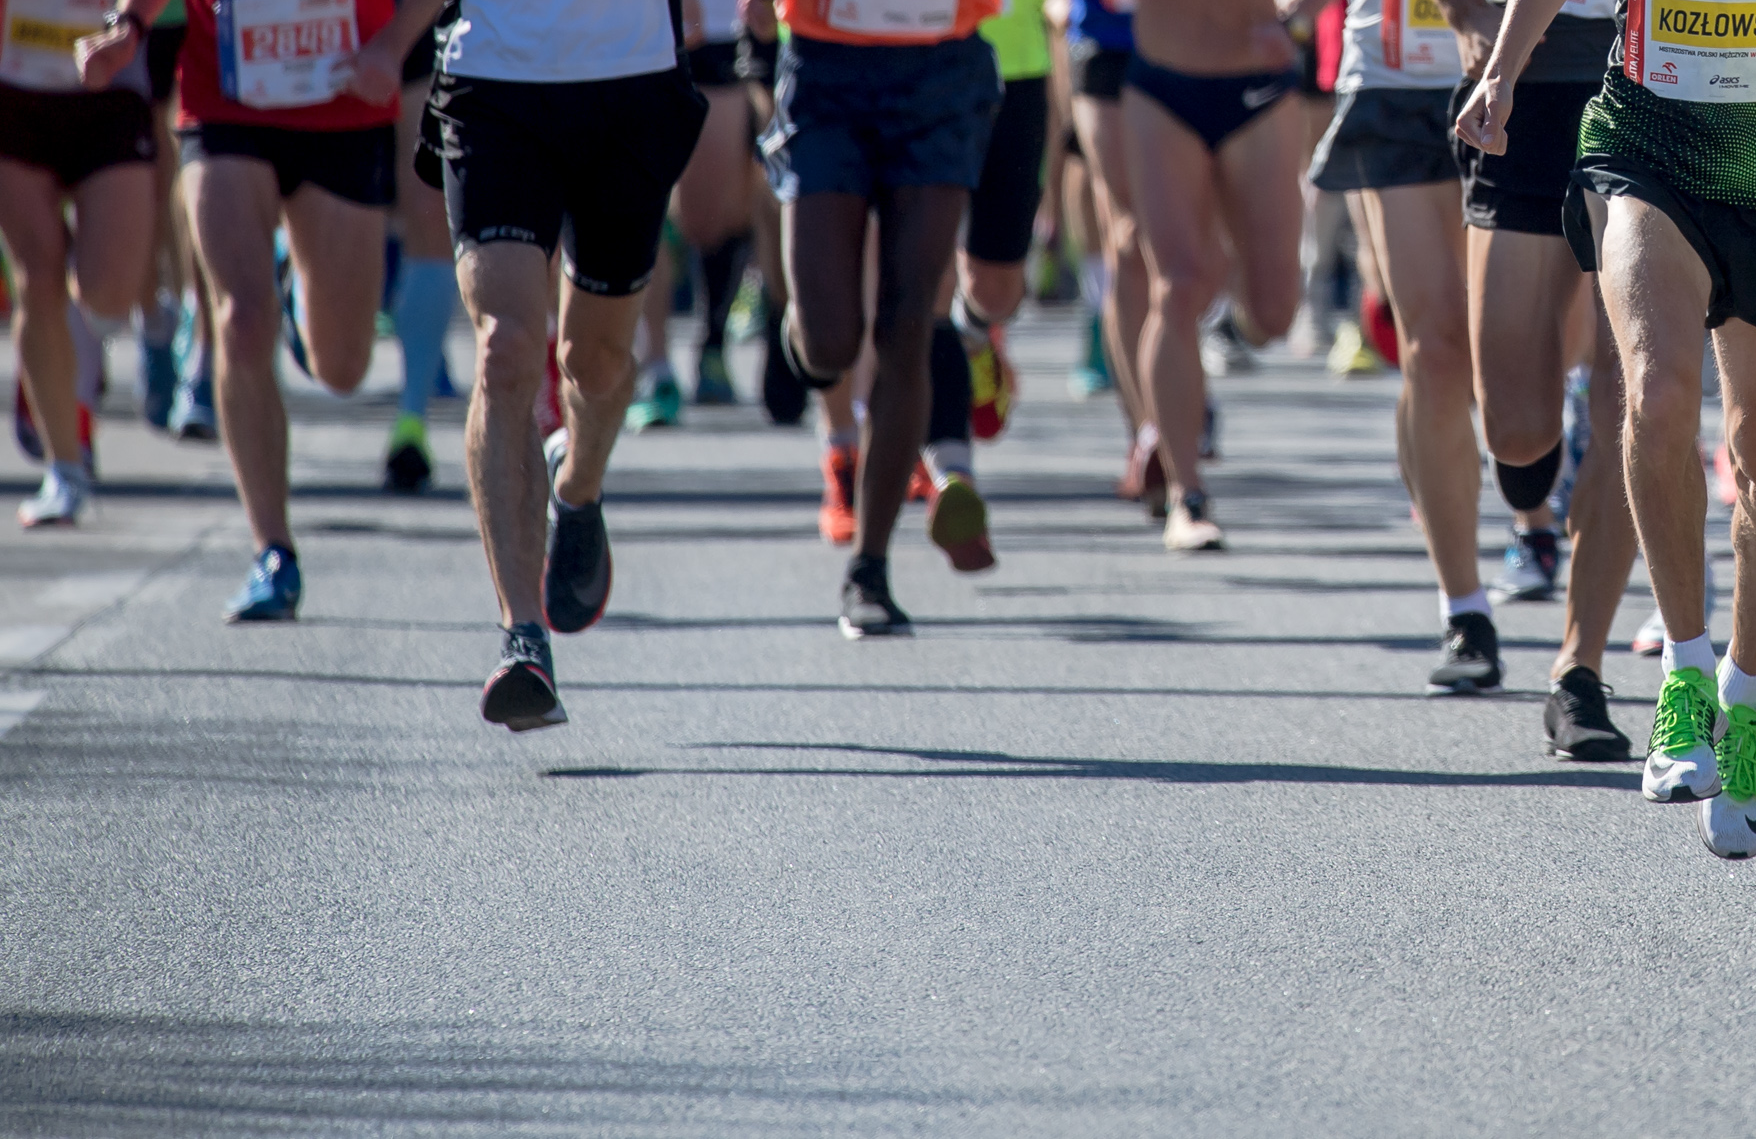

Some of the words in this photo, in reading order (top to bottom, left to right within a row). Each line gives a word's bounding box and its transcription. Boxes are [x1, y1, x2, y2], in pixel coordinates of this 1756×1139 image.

[1629, 30, 1639, 54] ELITE
[1659, 46, 1696, 56] MISTRZOSTWA
[1719, 51, 1749, 59] MĘŻCZYZN
[1651, 72, 1677, 83] ORLEN
[1720, 76, 1740, 84] asics
